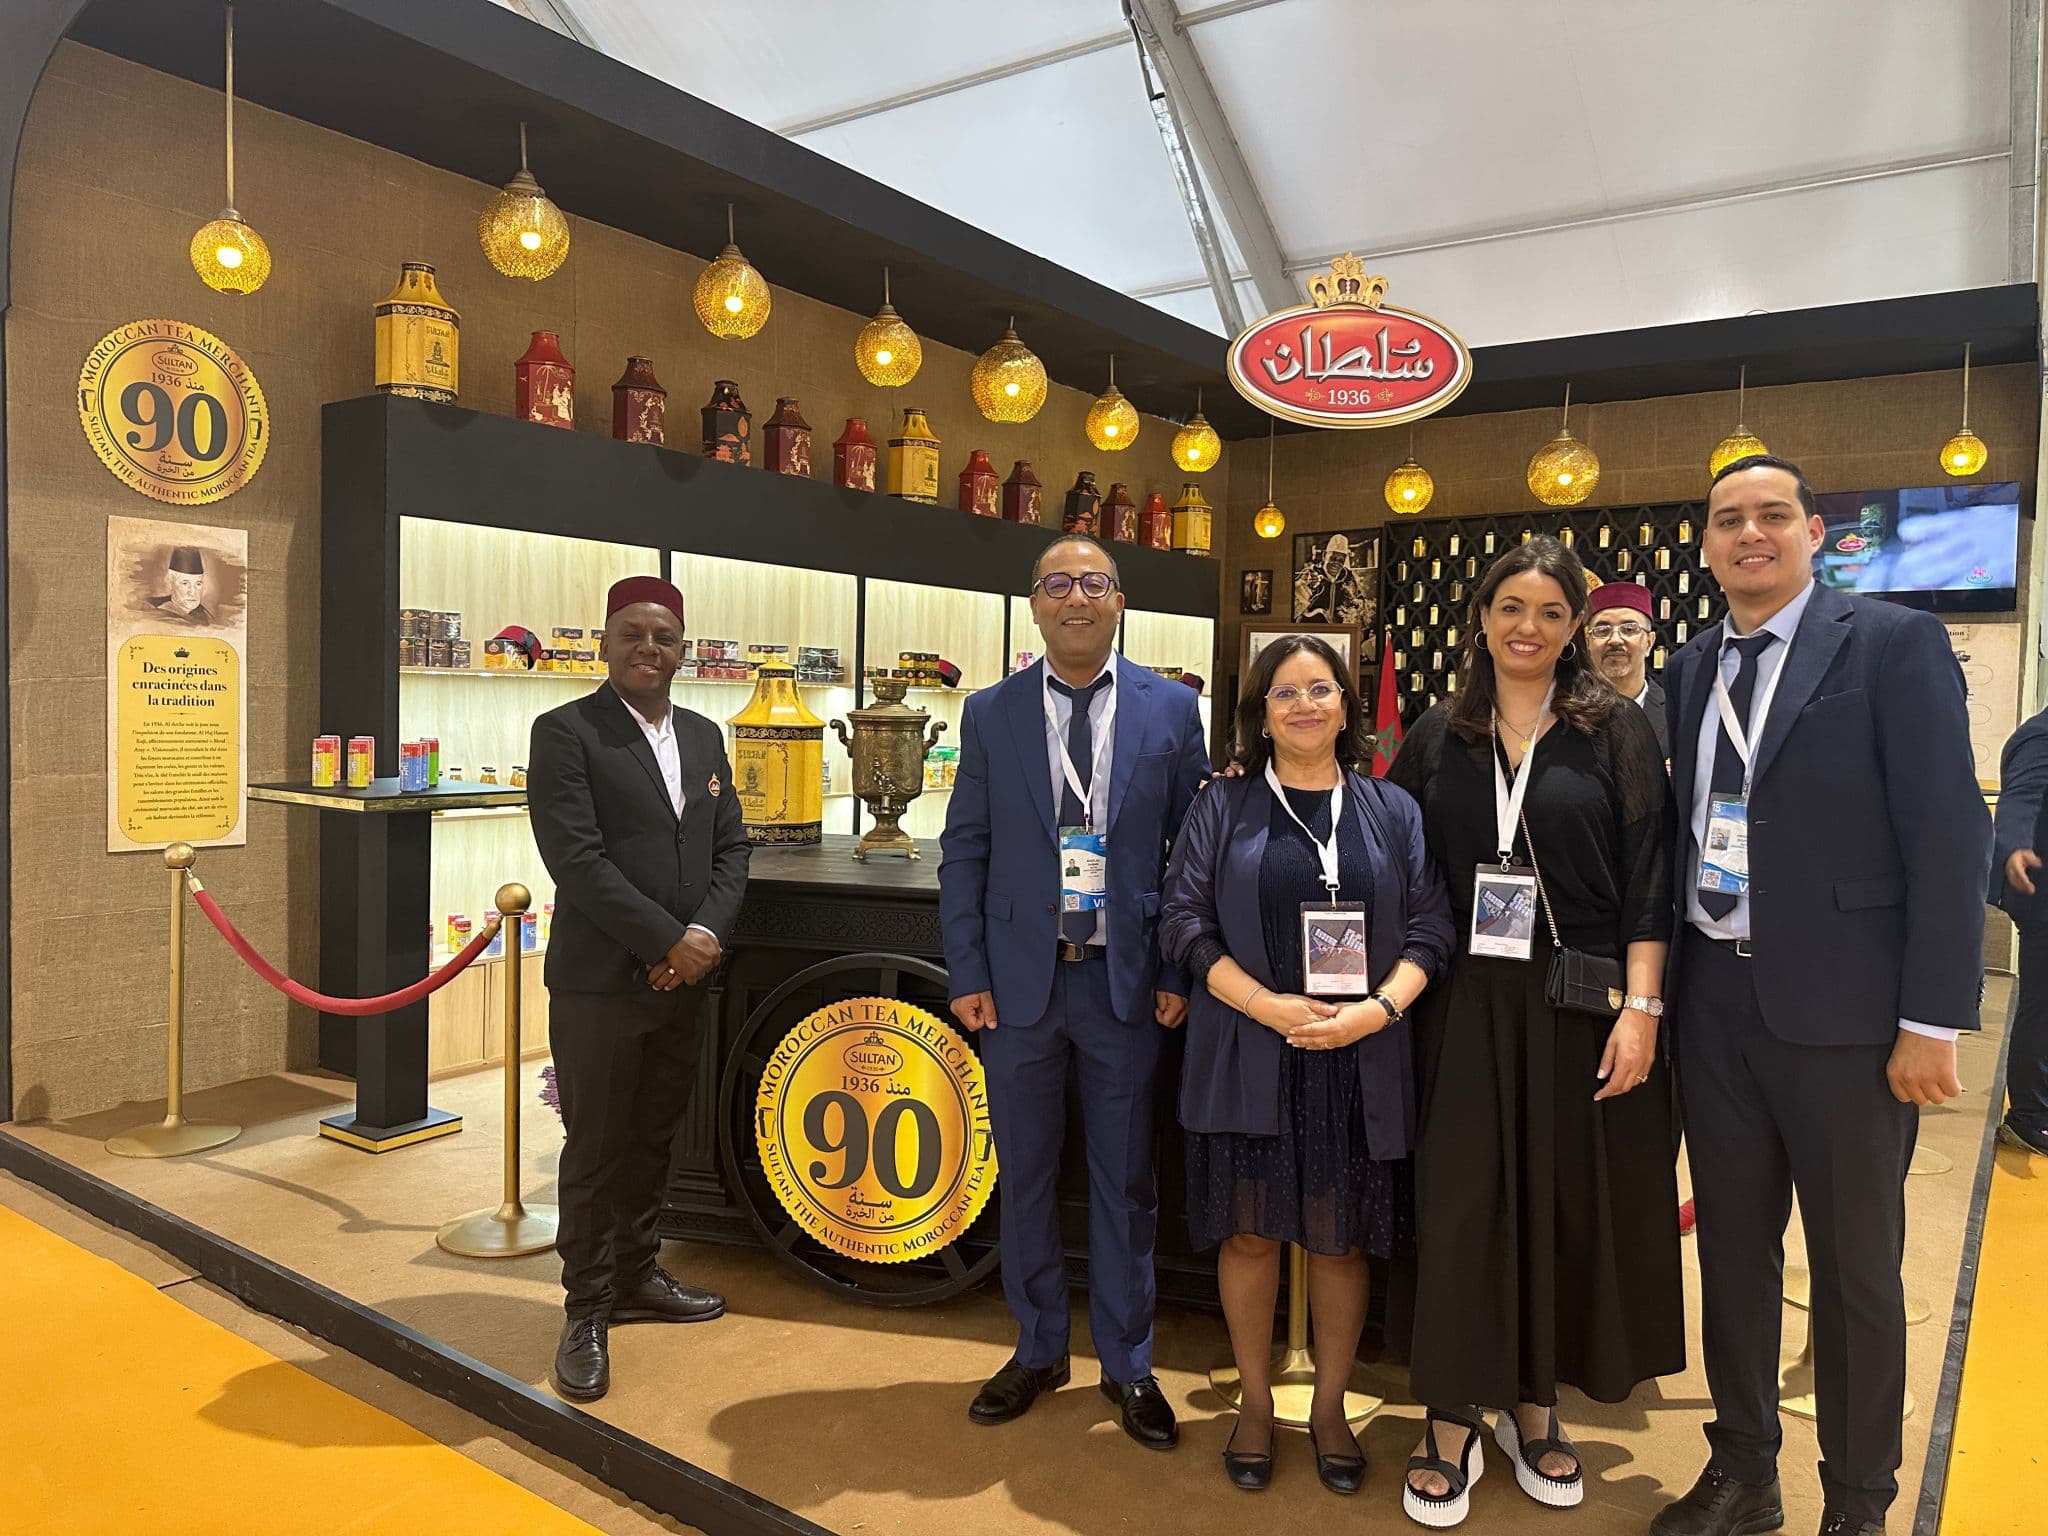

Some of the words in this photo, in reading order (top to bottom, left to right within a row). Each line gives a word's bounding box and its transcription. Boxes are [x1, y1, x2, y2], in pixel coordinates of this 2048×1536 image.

[84, 324, 158, 384] MOROCCAN
[164, 325, 194, 342] TEA
[200, 338, 261, 417] MERCHANT
[158, 356, 193, 369] SULTAN
[151, 373, 181, 387] 1936
[186, 378, 204, 391] منذ
[1327, 389, 1371, 406] 1936
[121, 382, 228, 461] 90
[89, 416, 111, 460] SULTAN,
[114, 458, 134, 480] THE
[136, 478, 198, 499] AUTHENTIC
[201, 460, 250, 497] MOROCCAN
[245, 442, 258, 460] TEA
[159, 450, 193, 467] سنة
[157, 464, 180, 474] الخبرة
[183, 469, 195, 477] من
[143, 661, 166, 674] Des
[169, 664, 217, 677] origines
[132, 678, 197, 691] enracinées
[200, 680, 227, 692] dans
[148, 694, 159, 706] la
[161, 695, 215, 707] tradition
[763, 1006, 854, 1100] MOROCCAN
[861, 1004, 899, 1025] TEA
[906, 1019, 992, 1129] MERCHANT
[850, 1051, 896, 1066] SULTAN
[841, 1076, 879, 1092] 1936
[886, 1078, 911, 1095] منذ
[804, 1090, 942, 1199] 90
[766, 1143, 792, 1202] SULTAN,
[793, 1198, 817, 1229] THE
[819, 1226, 900, 1255] AUTHENTIC
[903, 1194, 973, 1250] MOROCCAN
[967, 1166, 984, 1194] TEA
[849, 1187, 892, 1209] سنة
[845, 1205, 874, 1220] الخبرة
[879, 1213, 894, 1223] من
